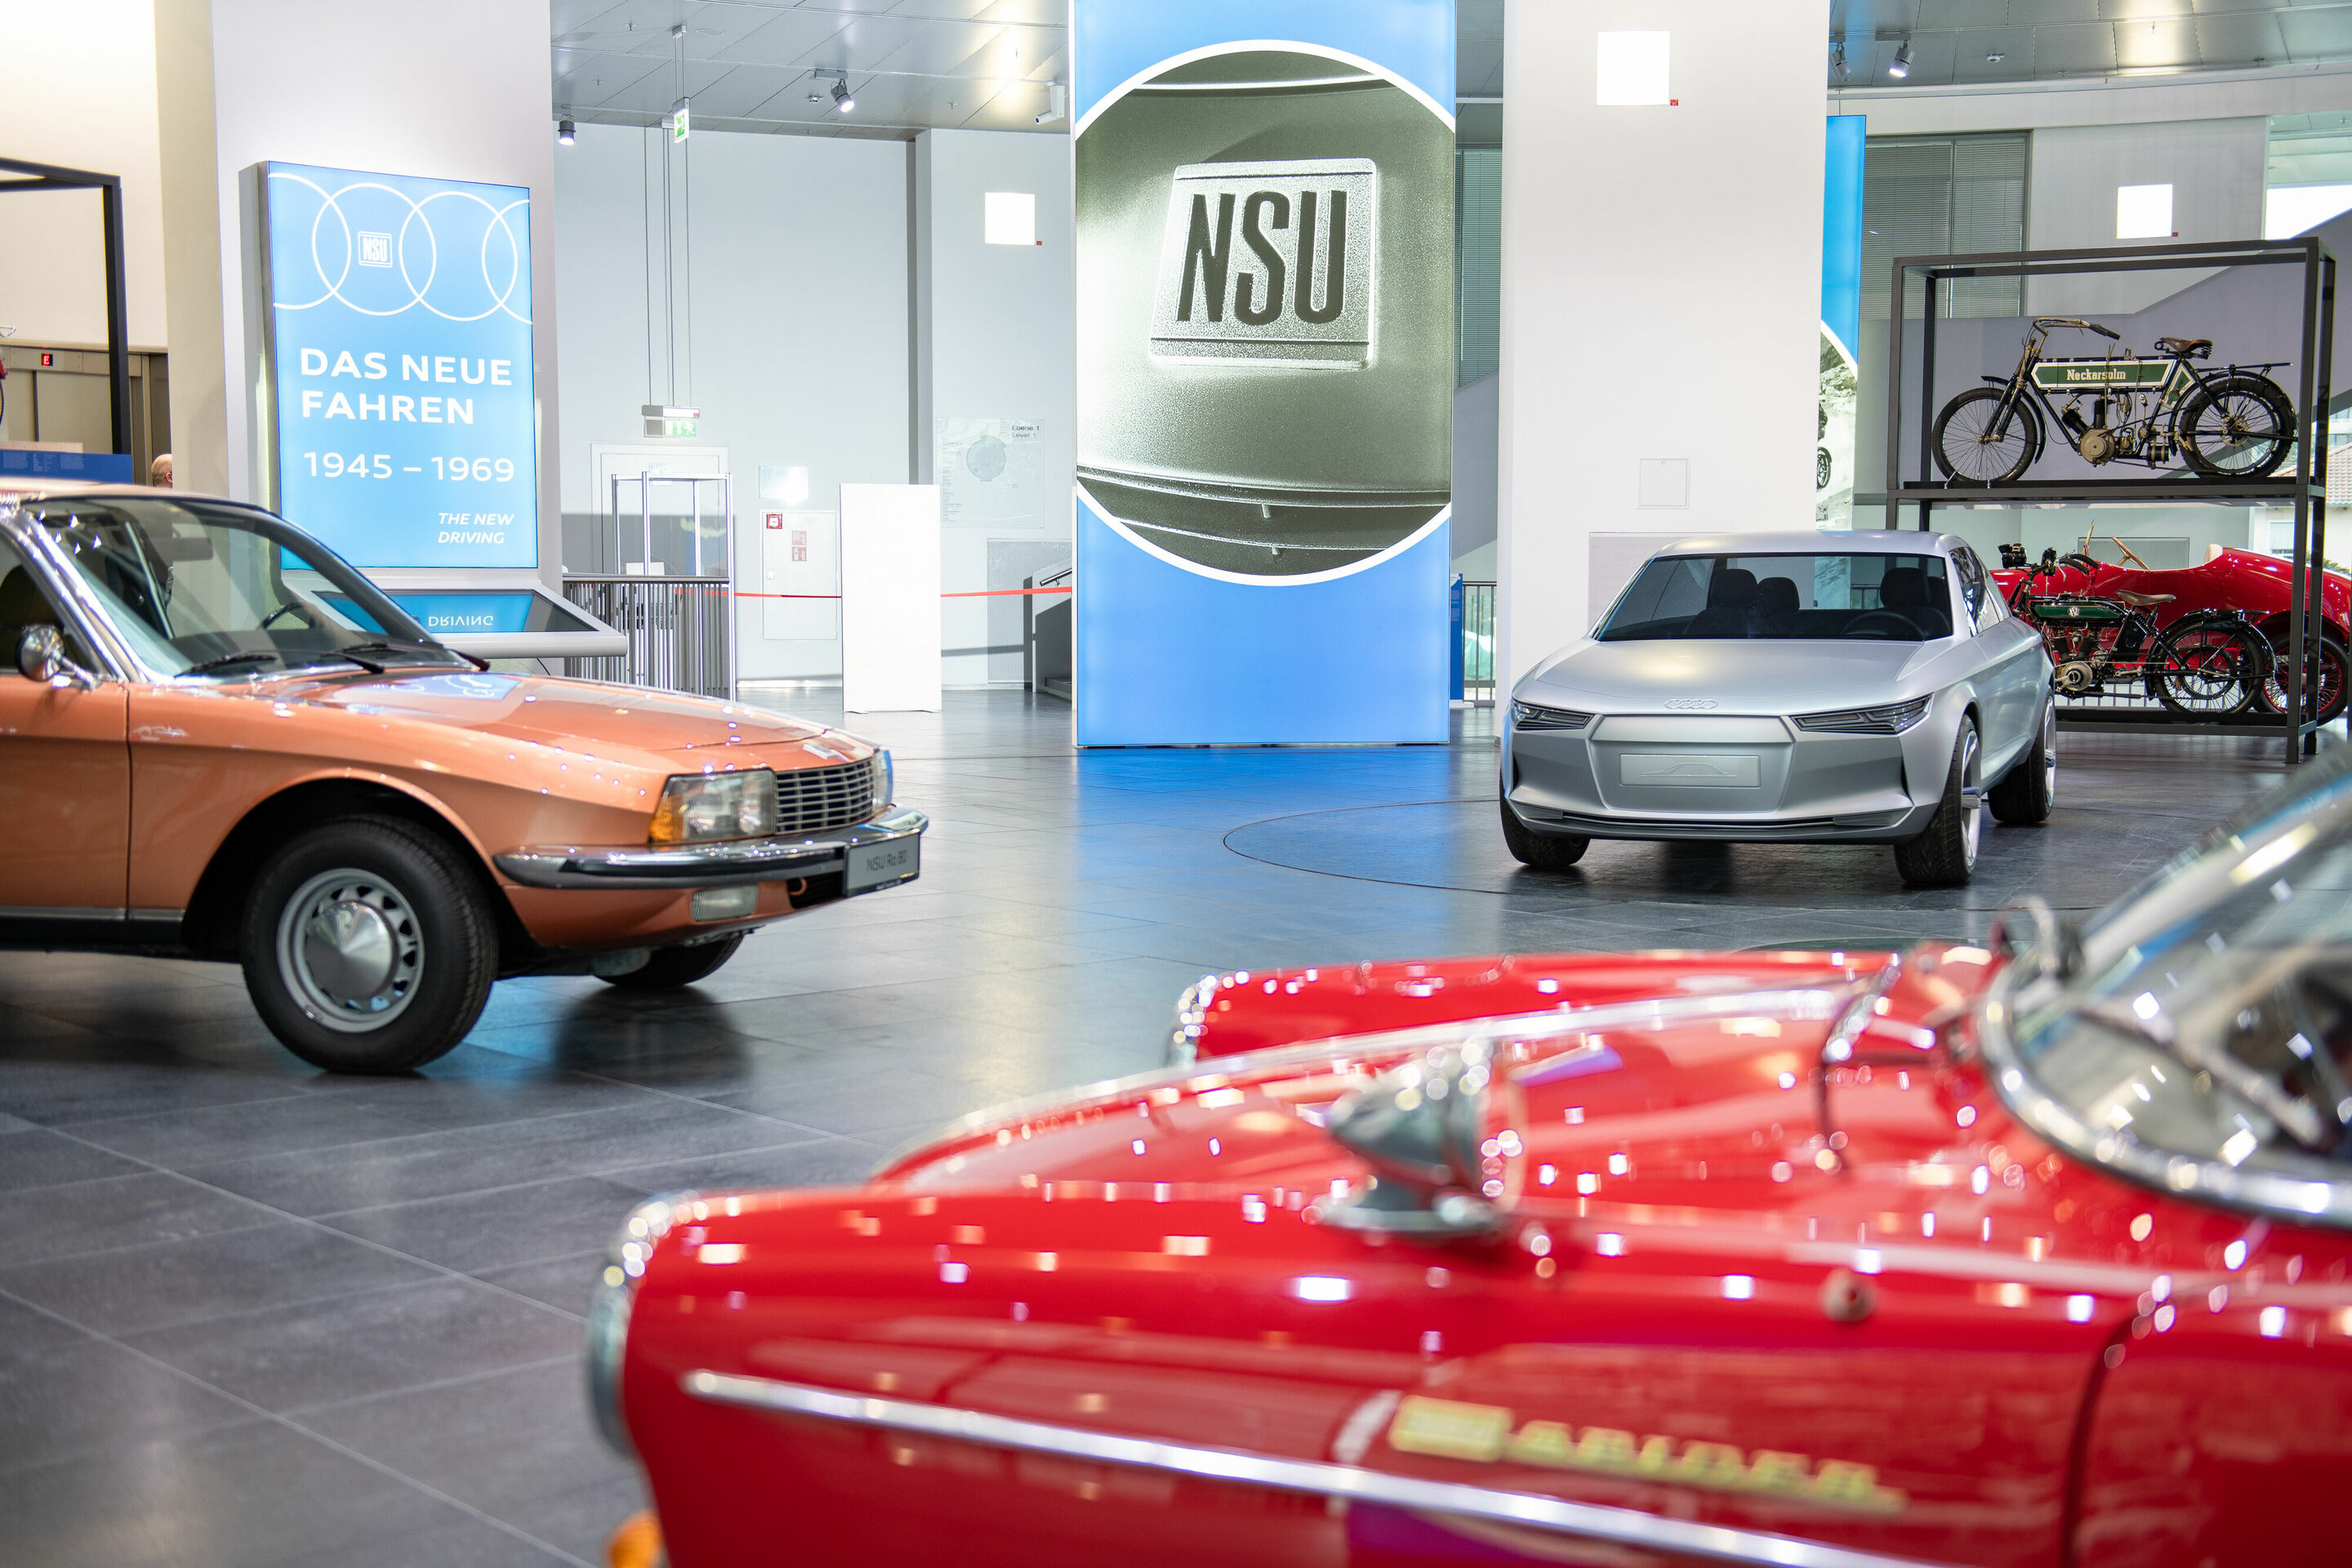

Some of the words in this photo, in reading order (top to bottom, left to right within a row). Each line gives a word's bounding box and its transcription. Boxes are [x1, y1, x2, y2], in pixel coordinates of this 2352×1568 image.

[363, 237, 389, 262] NSU
[1176, 189, 1348, 327] NSU
[301, 348, 388, 380] DAS
[403, 354, 512, 385] NEUE
[2066, 368, 2127, 381] Neckarsulm
[302, 390, 474, 425] FAHREN
[303, 452, 393, 479] 1945
[431, 457, 514, 482] 1969
[438, 513, 471, 525] THE
[474, 514, 514, 526] NEW
[438, 532, 506, 545] DRIVING
